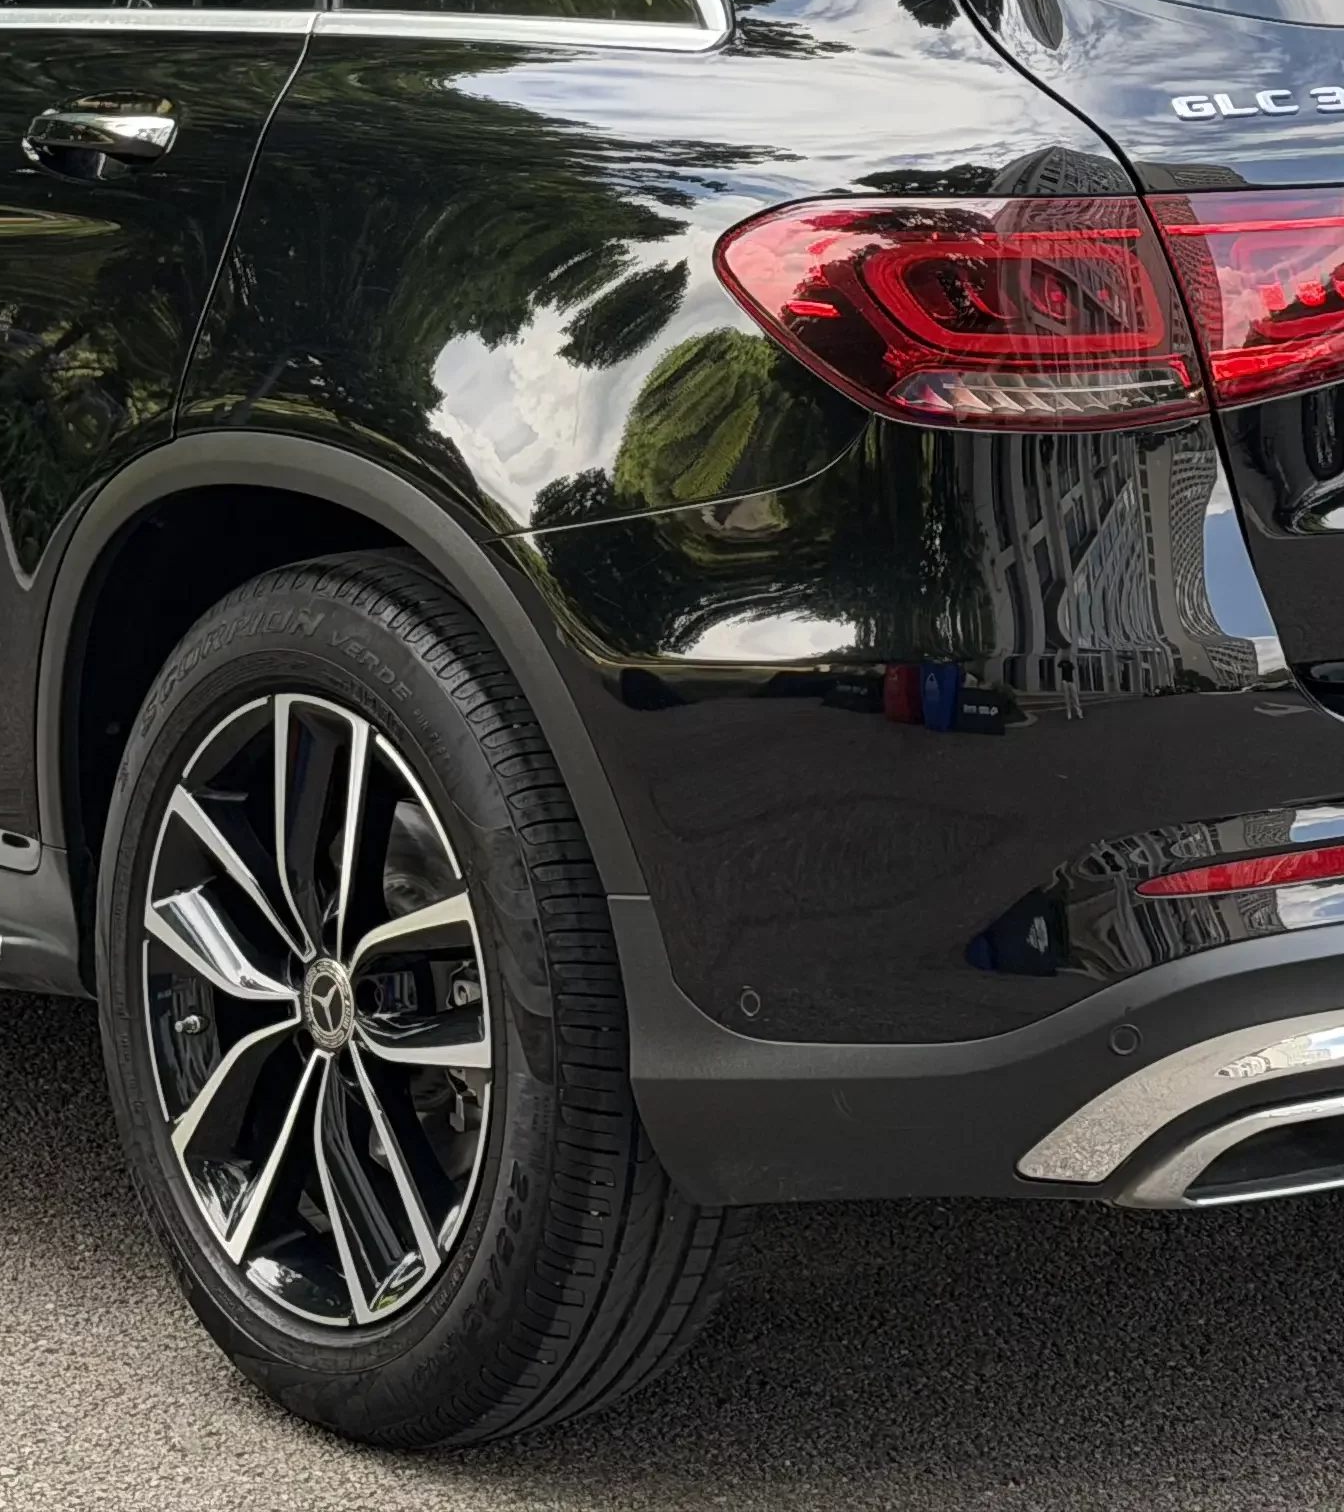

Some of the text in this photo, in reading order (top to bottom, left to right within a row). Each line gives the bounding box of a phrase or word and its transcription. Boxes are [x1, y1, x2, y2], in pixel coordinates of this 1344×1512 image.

[1171, 89, 1299, 121] GLC
[141, 608, 325, 738] SCORPION
[327, 631, 413, 702] VERDE
